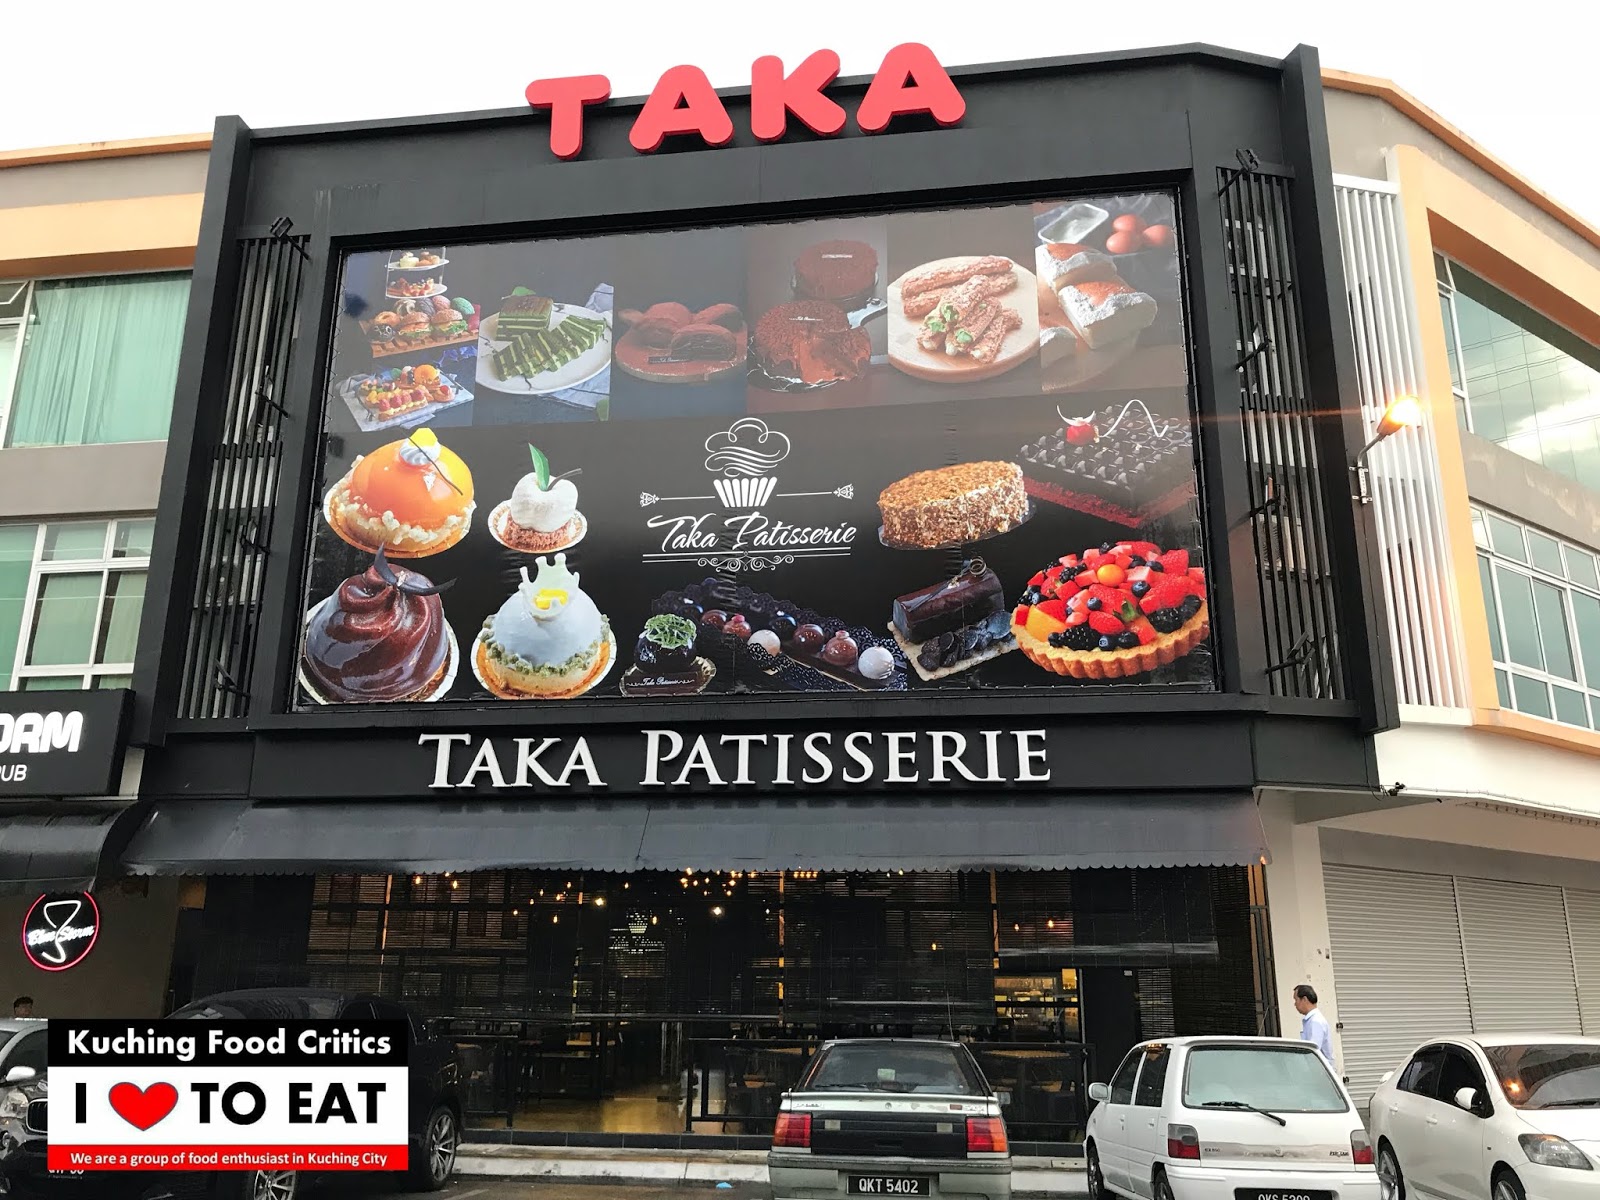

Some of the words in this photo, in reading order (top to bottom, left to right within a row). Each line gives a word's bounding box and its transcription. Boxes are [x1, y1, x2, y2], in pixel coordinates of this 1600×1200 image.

[525, 42, 966, 158] TAKA
[647, 513, 720, 553] Taka
[724, 511, 858, 551] Patisserie
[0, 764, 28, 782] UB
[418, 733, 608, 789] TAKA
[638, 728, 1052, 786] PATISSERIE
[858, 1178, 883, 1192] QKT
[886, 1178, 919, 1194] 5402
